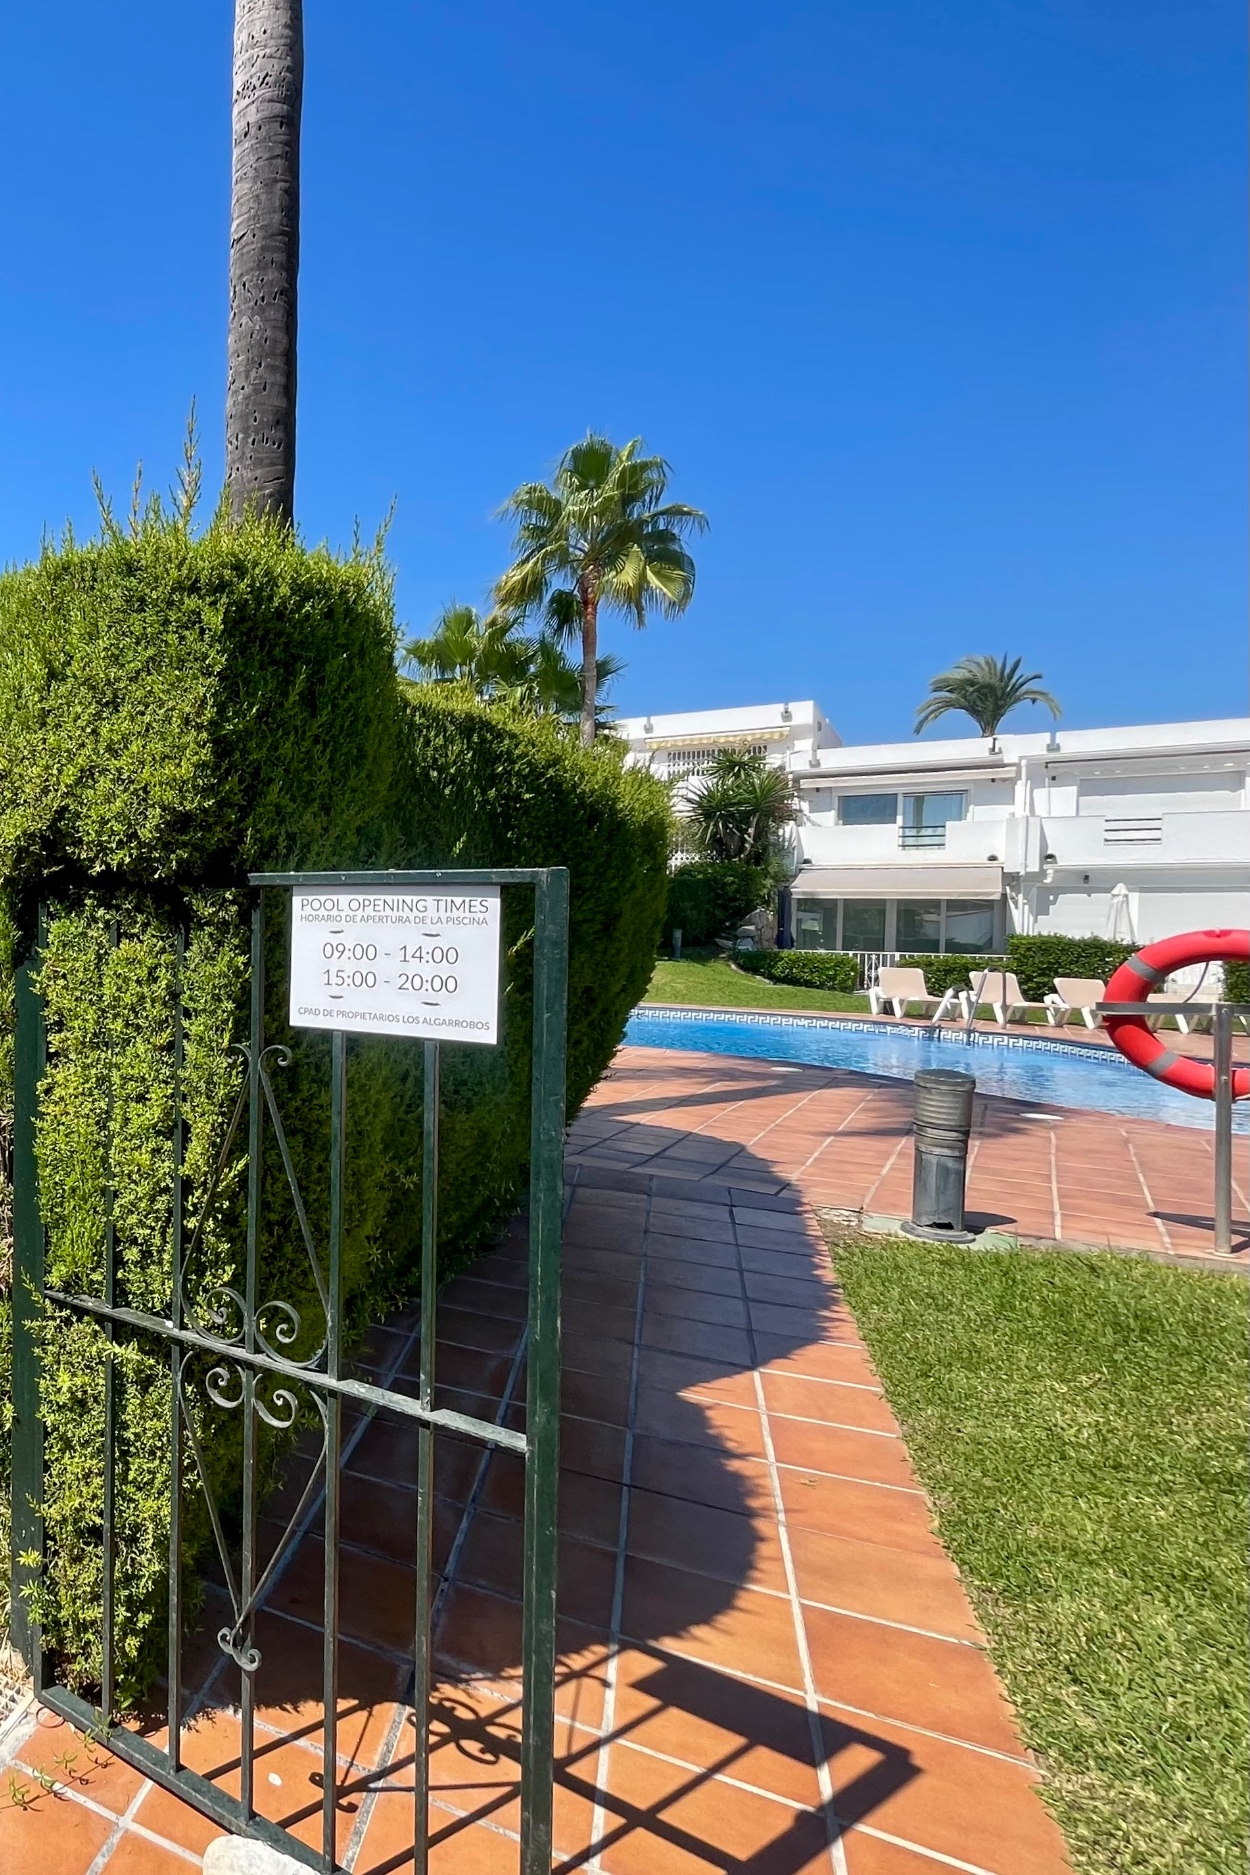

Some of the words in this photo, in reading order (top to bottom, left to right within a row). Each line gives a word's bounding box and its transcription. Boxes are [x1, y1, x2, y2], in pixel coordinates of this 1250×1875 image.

[301, 898, 344, 911] POOL
[348, 899, 428, 913] OPENING
[433, 899, 489, 914] TIMES
[300, 914, 342, 923] HORARIO
[345, 915, 358, 923] DE
[359, 915, 411, 924] APERTURA
[414, 916, 427, 925] DE
[430, 916, 443, 925] LA
[446, 917, 488, 926] PISCINA
[323, 942, 377, 961] 09:00
[399, 945, 459, 965] 14:00
[323, 969, 377, 988] 15:00
[398, 973, 458, 993] 20:00
[298, 1007, 321, 1016] CPAD
[323, 1008, 334, 1018] DE
[336, 1010, 400, 1023] PROPIETARIOS
[403, 1016, 420, 1024] LOS
[422, 1018, 490, 1030] ALGARROBOS
